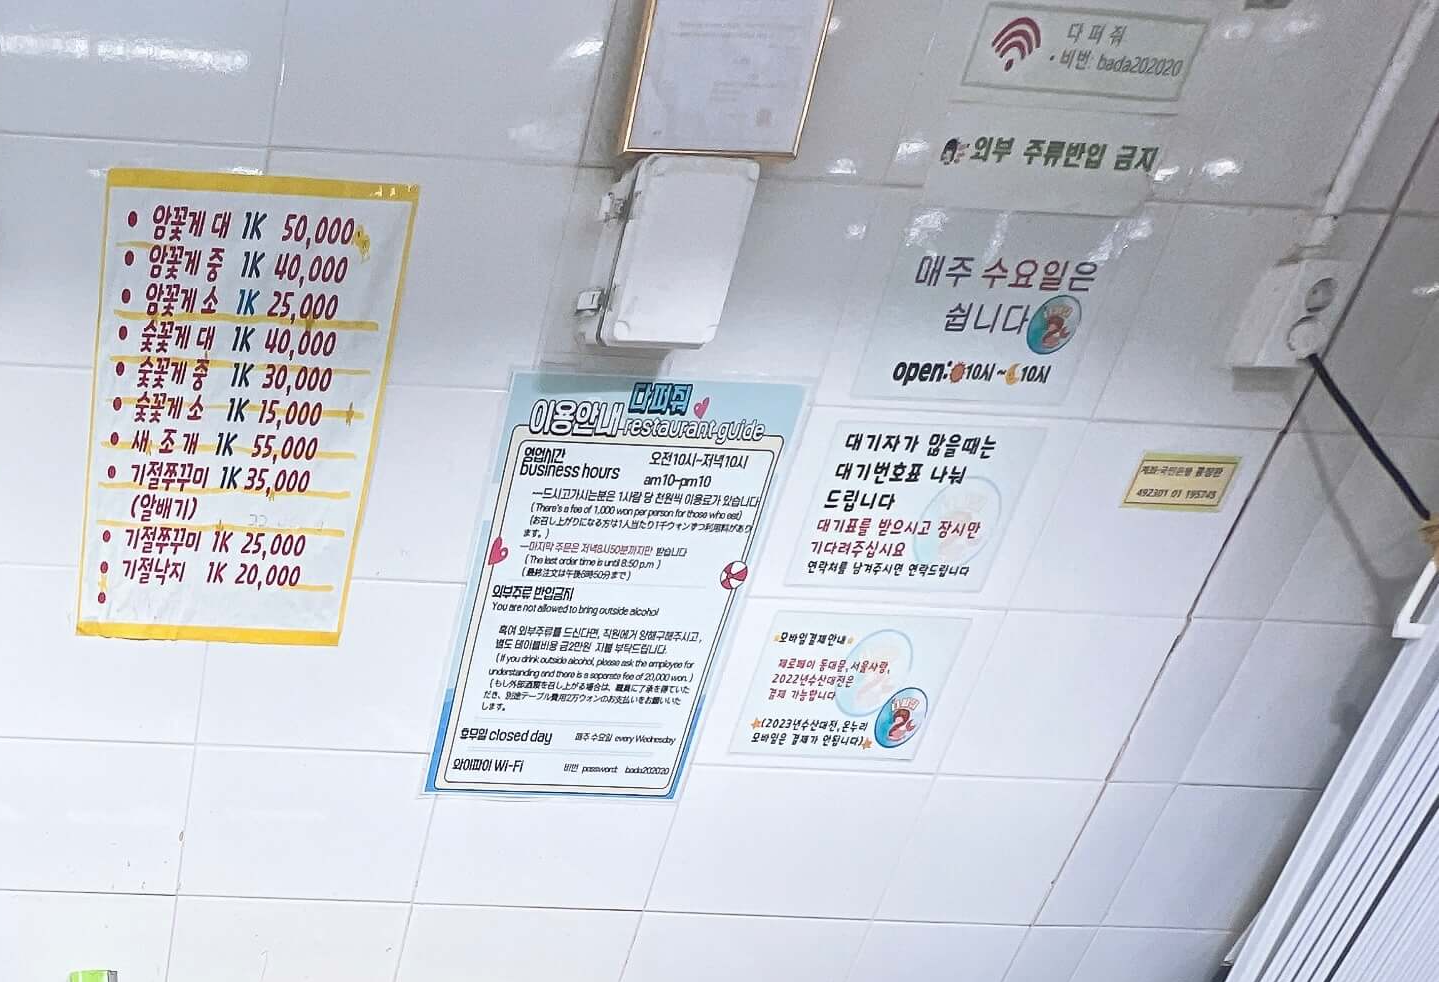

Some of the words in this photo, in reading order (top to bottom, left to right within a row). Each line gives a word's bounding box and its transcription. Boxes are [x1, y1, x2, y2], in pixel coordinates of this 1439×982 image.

[1096, 55, 1184, 78] bada202020
[970, 136, 1015, 164] 외부
[1023, 138, 1108, 170] 주류반입
[1113, 144, 1160, 172] 금지
[153, 205, 206, 241] 암꽃게
[211, 211, 232, 239] 대
[242, 211, 267, 240] 1K
[282, 213, 355, 249] 50,000
[149, 245, 202, 280] 암꽃게
[206, 247, 225, 282] 중
[241, 251, 265, 279] 1K
[274, 252, 349, 288] 40,000
[914, 255, 975, 288] 매주
[981, 257, 1099, 292] 수요일은
[146, 282, 198, 317] 암꽃게
[200, 285, 219, 315] 소
[236, 288, 260, 316] 1K
[266, 291, 339, 325] 25,000
[944, 302, 1032, 336] 쉽니다
[196, 326, 216, 351] 대
[231, 326, 256, 353] 1K
[264, 328, 337, 361] 40,000
[192, 358, 210, 392] 중
[230, 362, 254, 388] 1K
[261, 363, 333, 397] 30,000
[892, 360, 954, 386] open:
[186, 394, 204, 422] 소
[227, 398, 250, 423] 1K
[258, 400, 323, 431] 15,000
[528, 398, 626, 439] 이용안내
[625, 416, 717, 441] restaurant
[716, 420, 765, 445] guide
[215, 432, 238, 457] 1K
[251, 434, 319, 465] 55,000
[523, 446, 566, 464] 영업시간
[845, 433, 920, 453] 대기자가
[927, 433, 997, 459] 많을때는
[131, 461, 210, 492] 기절쭈꾸미
[219, 466, 243, 490] 1K
[244, 468, 311, 497] 35,000
[519, 462, 580, 479] business
[582, 463, 621, 480] hours
[835, 461, 924, 485] 대기번호표
[930, 465, 968, 485] 나눠
[130, 494, 198, 522] (알배기)
[644, 491, 654, 505] 당
[684, 493, 722, 507] 이용료가
[722, 495, 761, 508] 있습니다
[824, 489, 896, 513] 드립니다
[816, 517, 873, 536] 대기표를
[878, 518, 932, 536] 받으시고
[125, 526, 202, 555] 기절쭈꾸미
[212, 530, 234, 553] 1K
[240, 532, 306, 561] 25,000
[811, 541, 906, 559] 기다려주십시요
[122, 557, 187, 586] 기절낙지
[206, 562, 228, 584] 1K
[234, 563, 301, 591] 20,000
[807, 560, 849, 575] 연락처를
[852, 561, 904, 576] 남겨주시면
[908, 562, 970, 578] 연락드립니다
[491, 584, 533, 600] 외부주류
[533, 586, 575, 601] 반입금지
[492, 601, 508, 613] You
[522, 603, 536, 613] not
[537, 603, 569, 614] allowed
[578, 605, 599, 617] bring
[777, 657, 816, 670] 제로페이
[771, 673, 855, 688] 2022년수산대전은
[768, 688, 787, 701] 결제
[790, 689, 837, 702] 가능합니다
[488, 729, 530, 743] closed
[530, 729, 553, 746] day
[750, 732, 788, 745] 모바일은
[790, 734, 819, 746] 결제가
[452, 758, 493, 772] 와이파이
[494, 759, 524, 773] Wi-Fi
